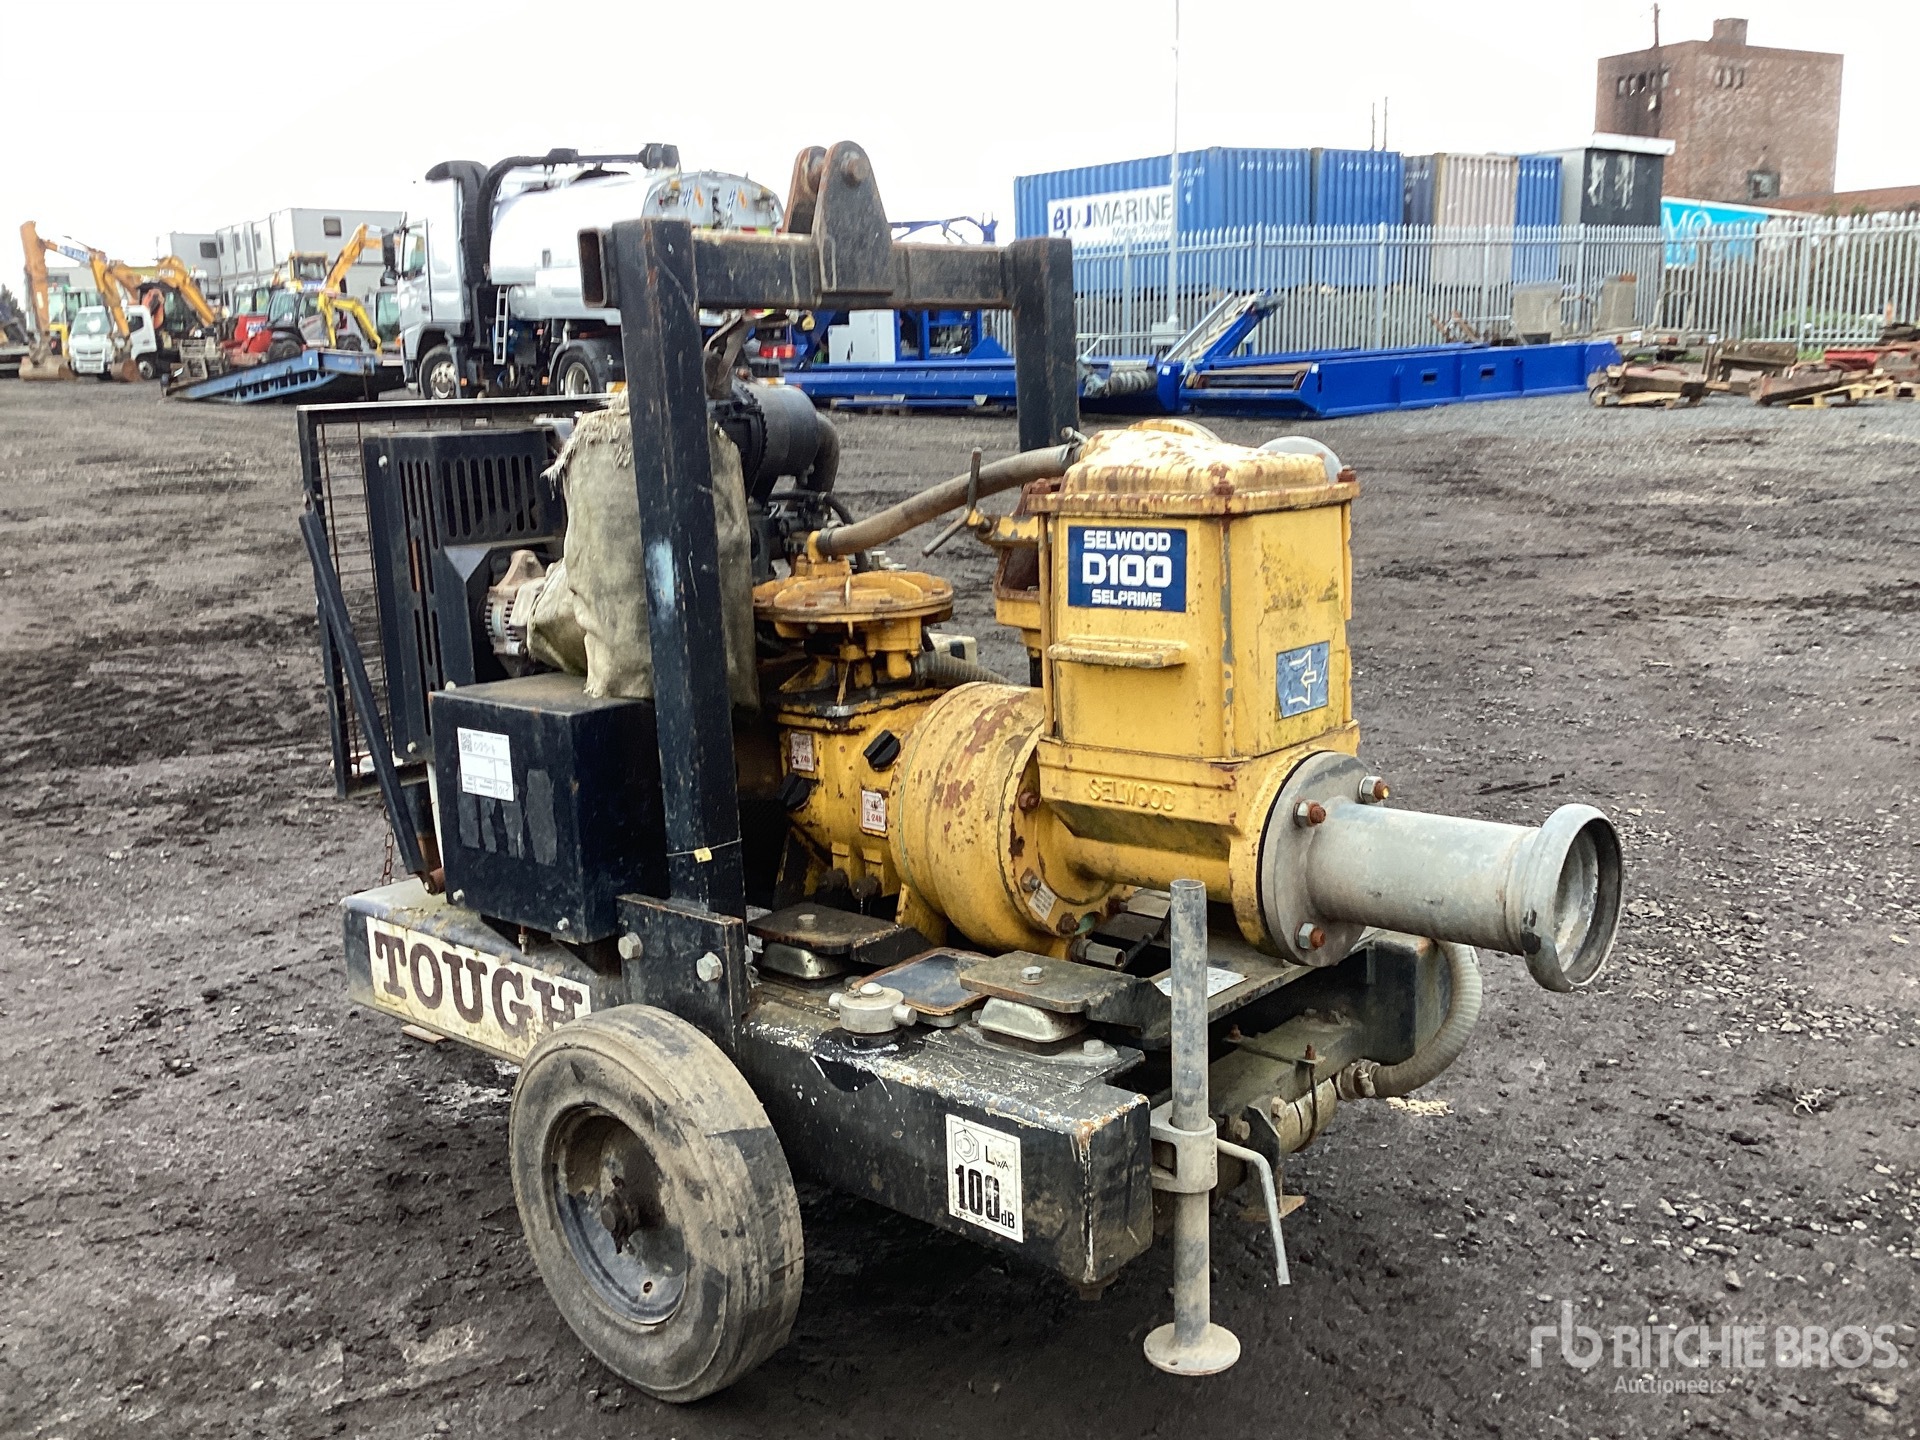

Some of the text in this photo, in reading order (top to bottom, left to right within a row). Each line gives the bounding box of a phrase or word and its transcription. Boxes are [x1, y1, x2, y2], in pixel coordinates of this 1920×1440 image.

[1084, 529, 1171, 552] SELWOOD
[1082, 552, 1172, 588] D100
[1091, 588, 1162, 608] SELPRIME
[1088, 778, 1176, 812] SELWOOD
[374, 930, 584, 1044] TOUGH
[955, 1164, 1000, 1222] 100
